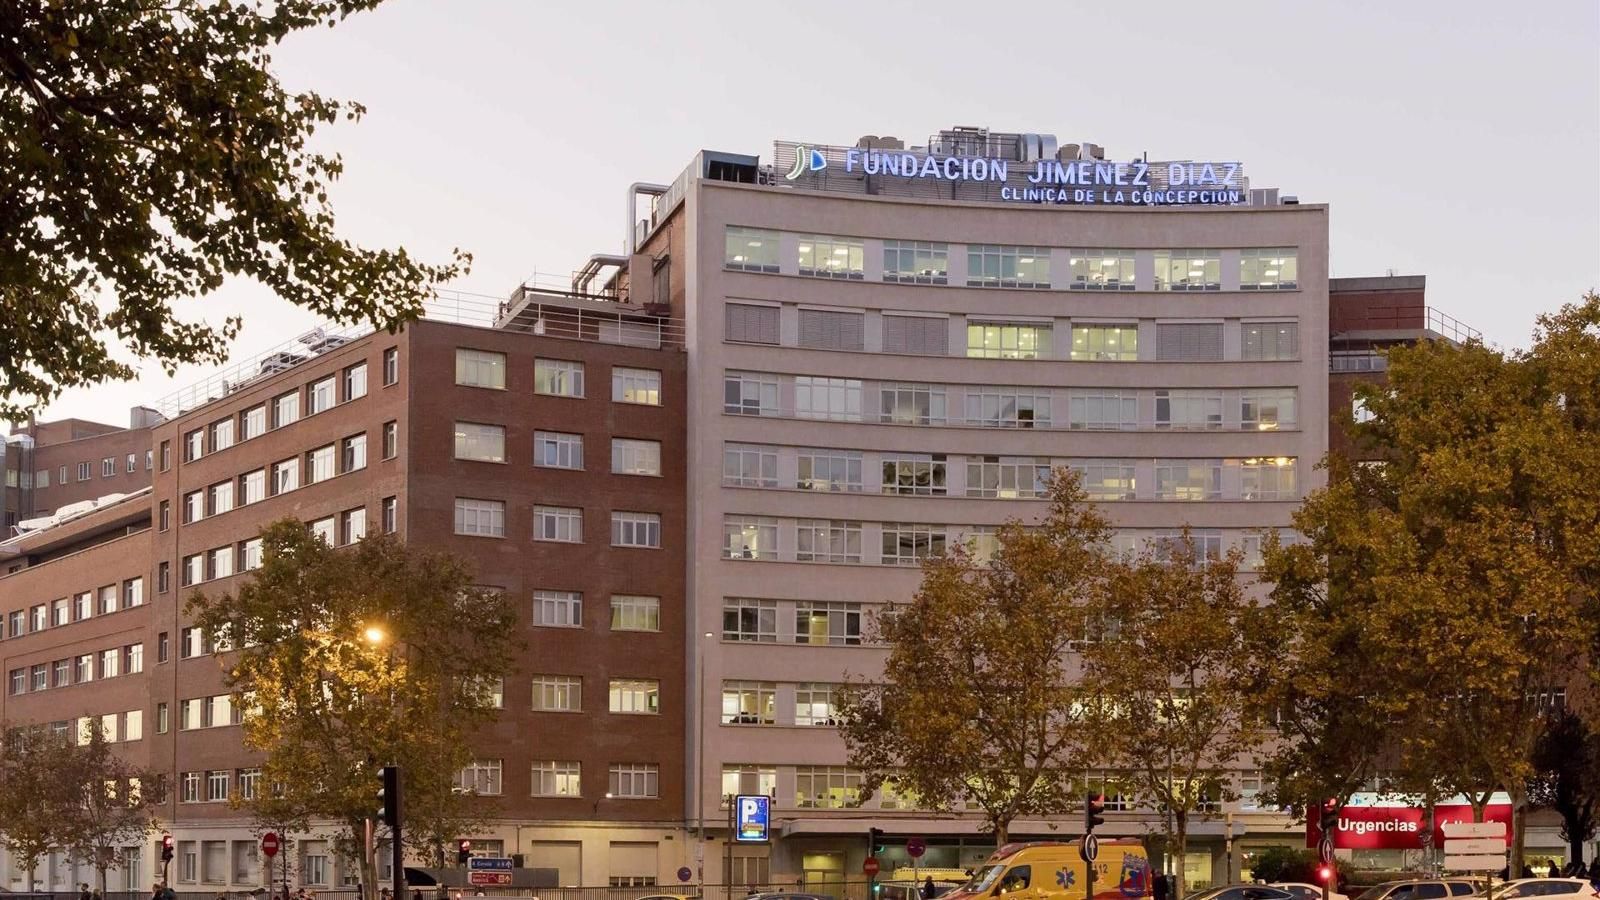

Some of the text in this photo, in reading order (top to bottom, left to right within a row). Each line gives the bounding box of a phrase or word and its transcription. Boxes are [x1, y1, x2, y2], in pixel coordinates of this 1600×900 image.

[846, 150, 1239, 186] FUNDACION JIMENEZ DIAZ
[1001, 187, 1239, 204] CLINICA DE LA CONCEPCION
[742, 798, 758, 824] P
[1338, 818, 1418, 835] Urgencias
